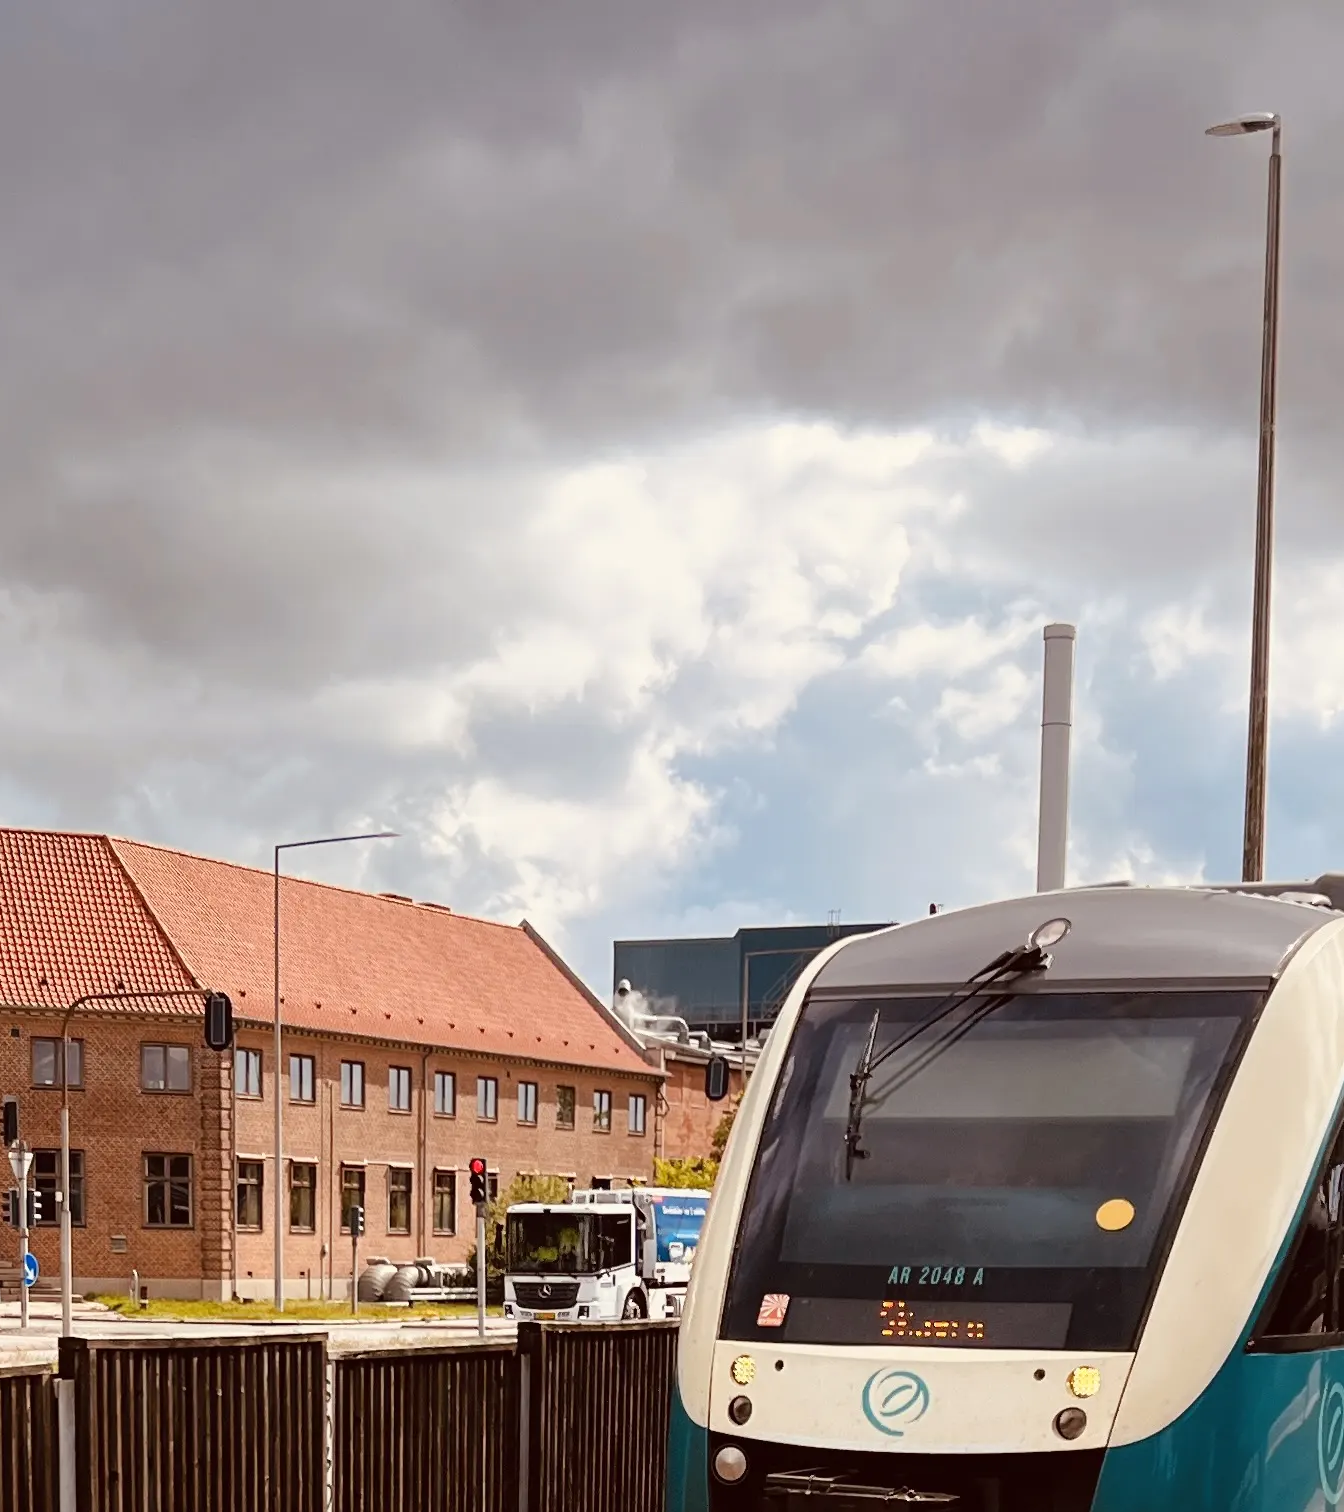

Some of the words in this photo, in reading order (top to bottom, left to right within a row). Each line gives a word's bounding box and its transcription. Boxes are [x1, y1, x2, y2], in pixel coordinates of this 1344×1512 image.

[887, 1266, 912, 1285] AR
[918, 1266, 966, 1285] 2048
[973, 1267, 984, 1285] A
